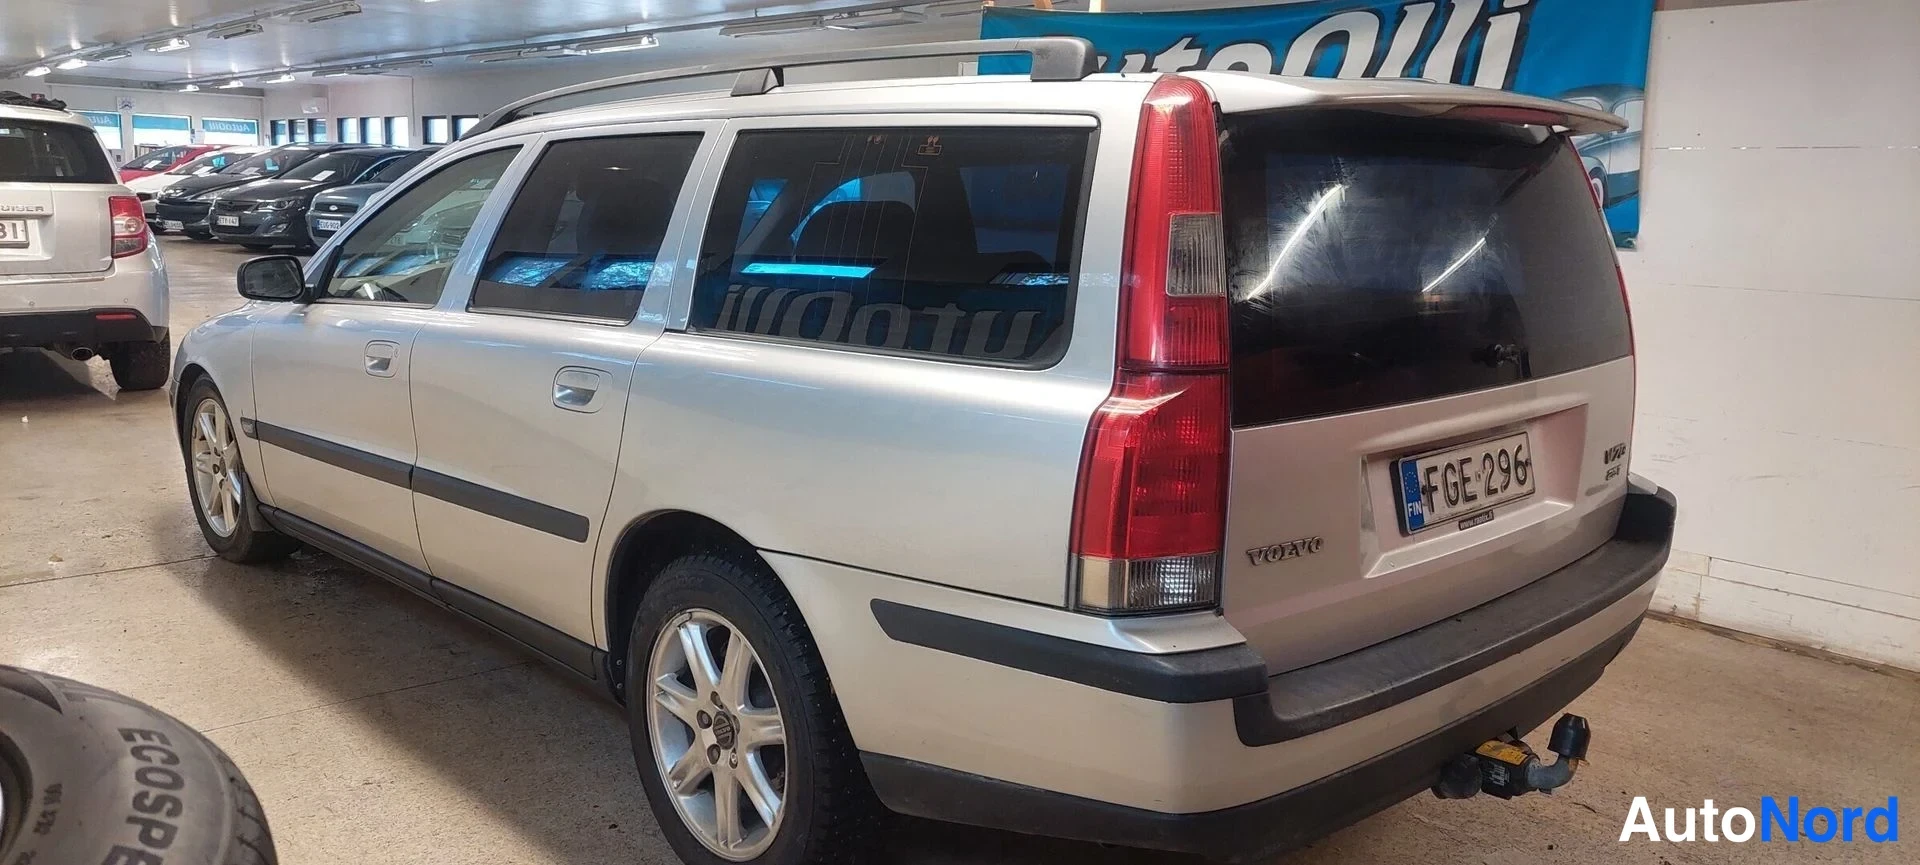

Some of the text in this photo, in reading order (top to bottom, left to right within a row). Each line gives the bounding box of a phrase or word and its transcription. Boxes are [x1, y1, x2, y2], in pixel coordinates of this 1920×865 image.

[1424, 444, 1528, 513] FGE-296
[1407, 500, 1423, 517] FIN
[1245, 535, 1325, 566] VOLVO
